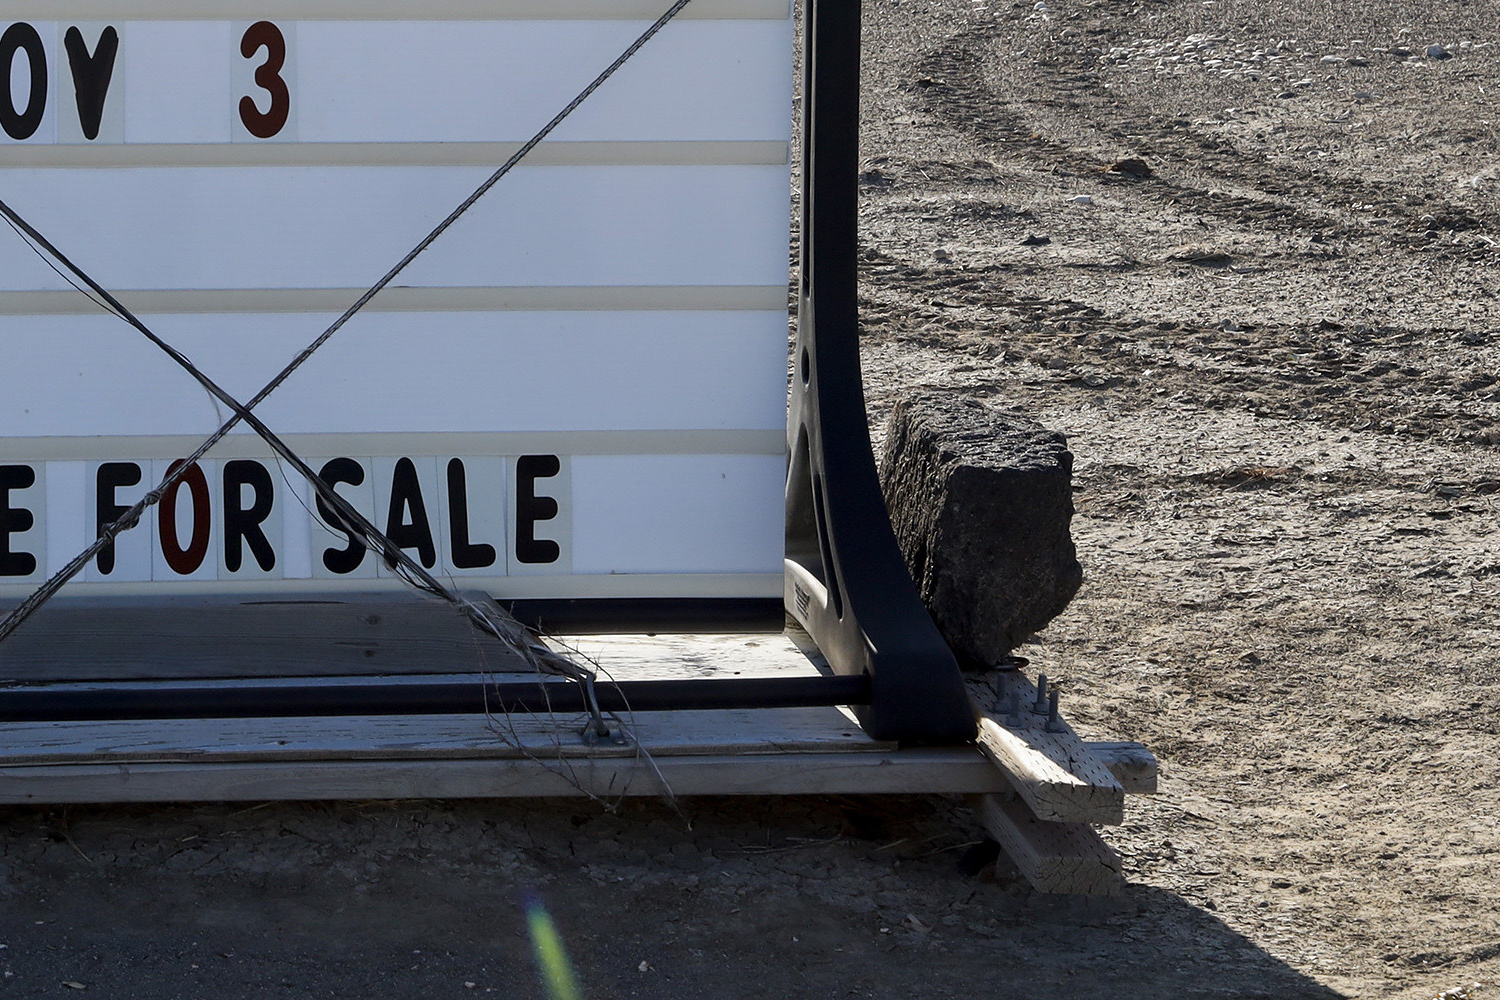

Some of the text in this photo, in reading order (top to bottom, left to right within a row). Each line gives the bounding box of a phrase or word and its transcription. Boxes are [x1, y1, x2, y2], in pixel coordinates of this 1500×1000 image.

[239, 21, 290, 138] 3
[96, 459, 276, 575] FOR
[315, 455, 561, 573] SALE
